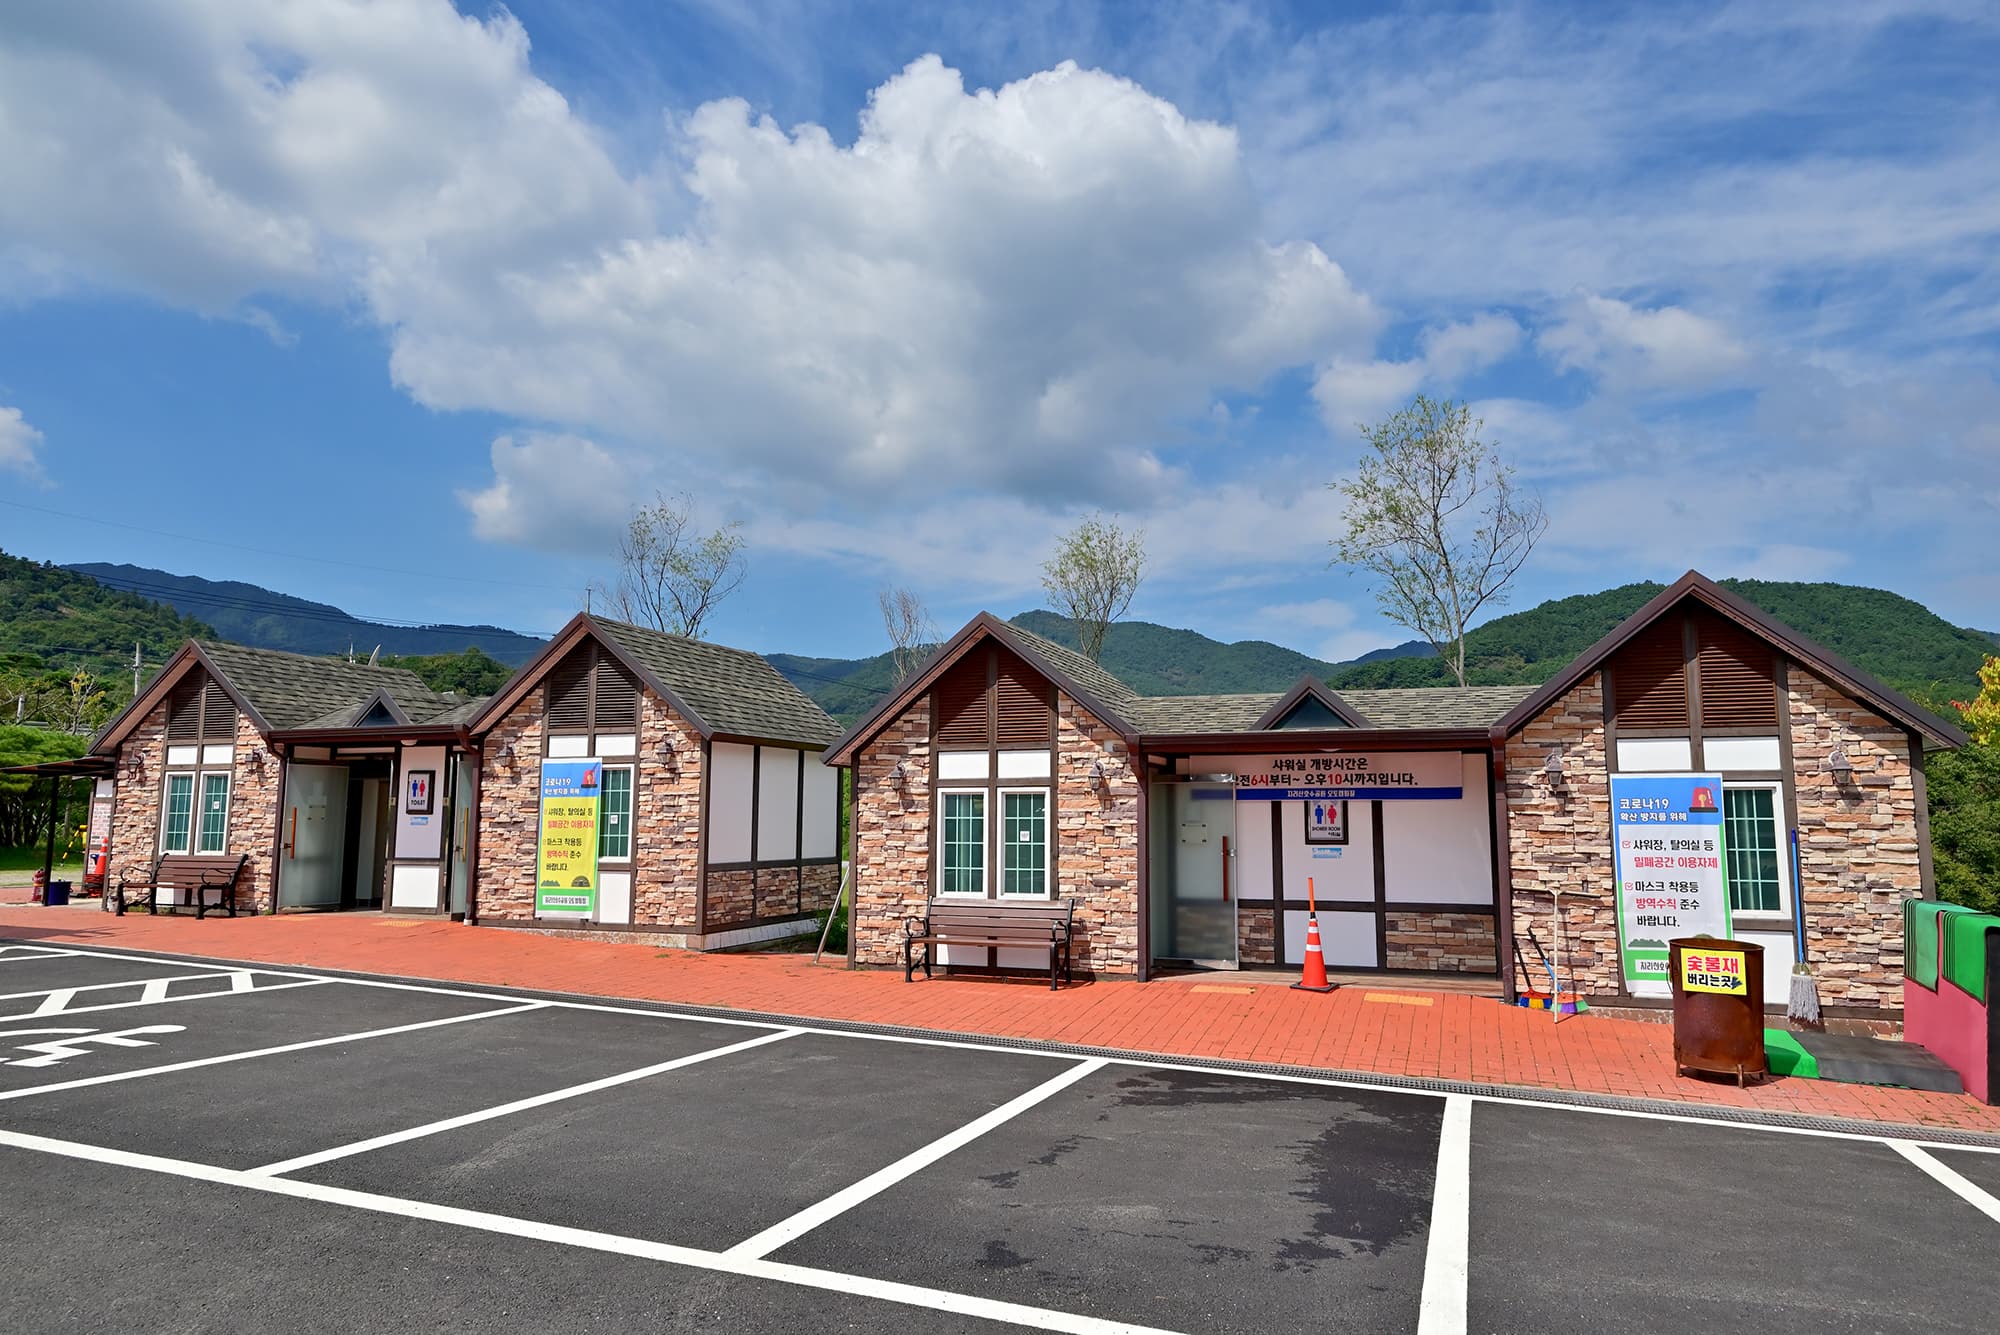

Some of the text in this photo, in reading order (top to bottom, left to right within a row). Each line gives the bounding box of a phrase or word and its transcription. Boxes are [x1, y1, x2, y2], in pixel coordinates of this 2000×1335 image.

[1272, 757, 1368, 771] 샤워실 개방시간은
[545, 777, 572, 786] 코로나19
[1304, 772, 1419, 786] 오후10시까지입니다.
[1619, 798, 1669, 810] 코로나19
[548, 808, 593, 816] 샤워장, 탈의실 등
[1620, 812, 1688, 822] 확산 방지를 위해
[571, 820, 594, 829] 이용자제
[547, 838, 582, 847] 마스크 착용등
[1633, 839, 1714, 852] 샤워장, 탈의실 등
[570, 850, 582, 859] 준수
[546, 863, 568, 871] 바랍니다.
[1634, 856, 1718, 868] 밀폐공간 이용자제
[1635, 880, 1699, 893] 마스크 착용등
[1635, 897, 1700, 910] 방역수칙 준수
[1636, 915, 1680, 927] 바랍니다.
[1687, 955, 1739, 974] 숯불재
[1687, 973, 1731, 988] 버리는곳
